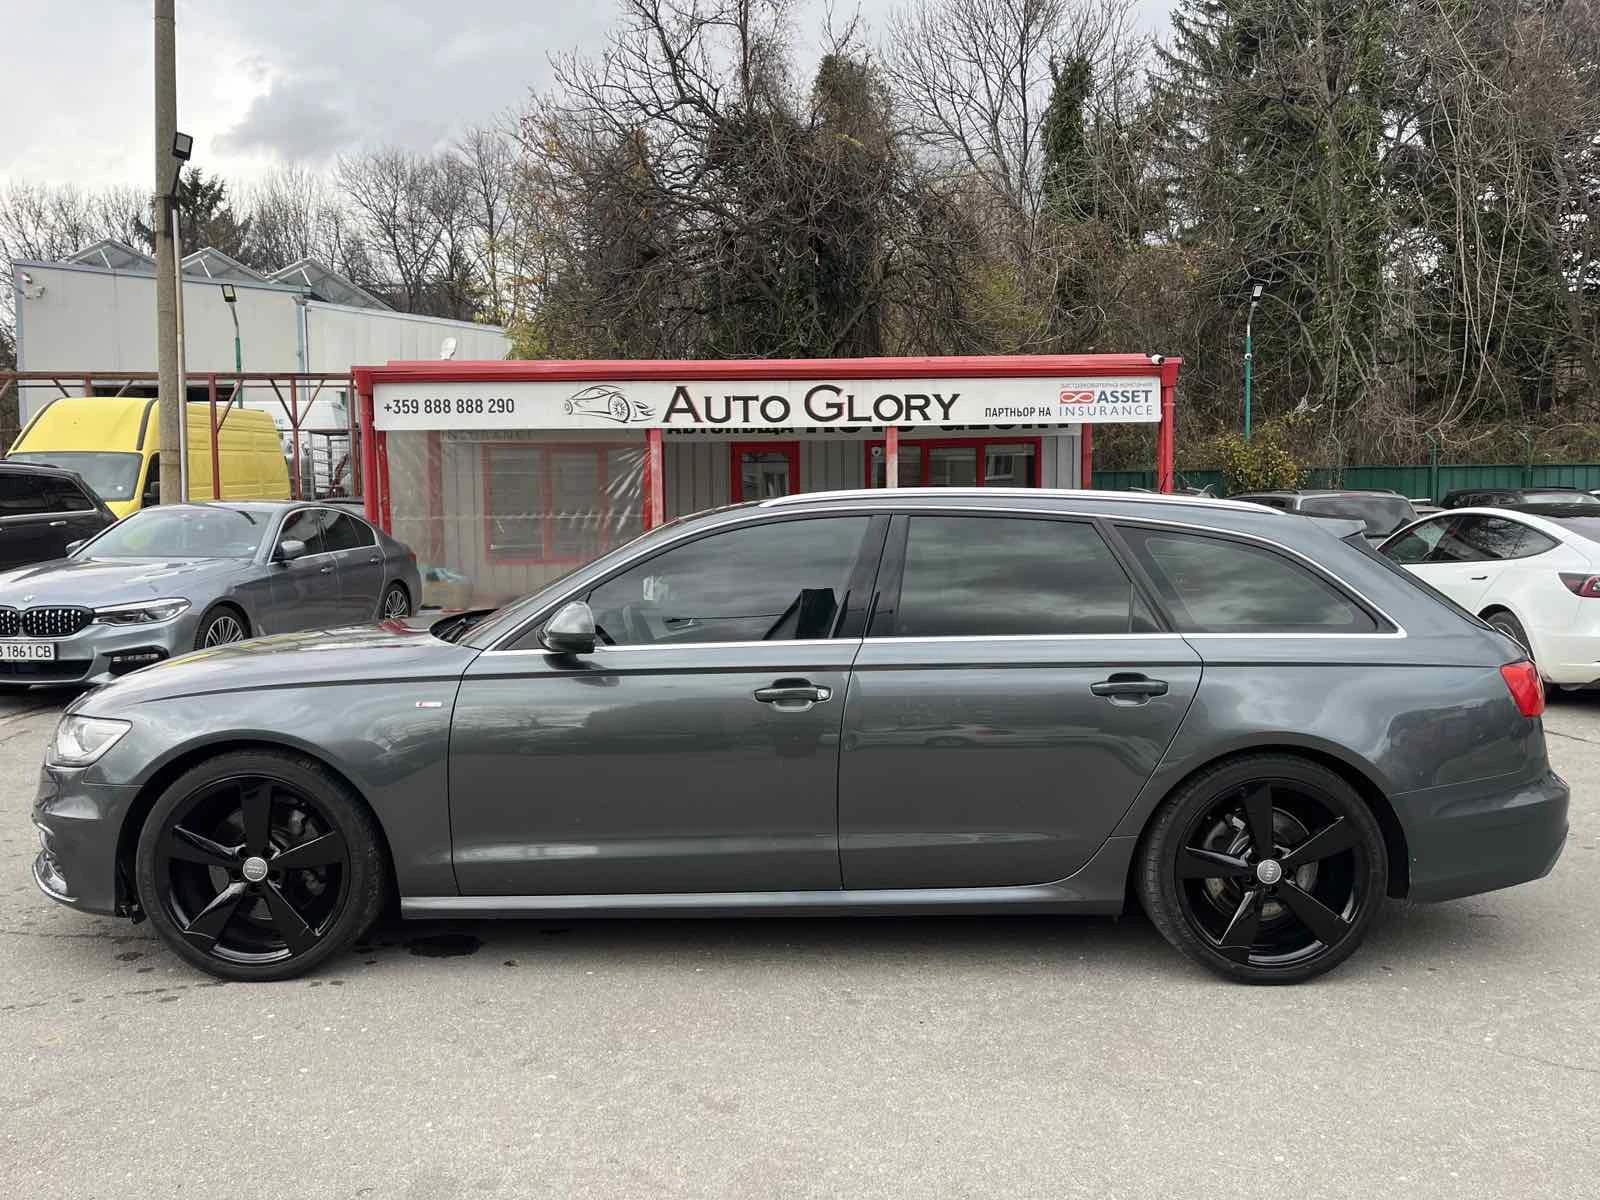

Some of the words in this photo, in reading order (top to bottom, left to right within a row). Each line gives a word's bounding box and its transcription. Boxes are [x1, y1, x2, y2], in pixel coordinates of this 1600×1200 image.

[1097, 390, 1153, 403] ASSET
[384, 399, 419, 414] +359
[424, 399, 451, 414] 888
[456, 398, 484, 414] 888
[488, 398, 515, 414] 290
[985, 407, 1035, 417] ПАРТНЬОР
[1038, 406, 1052, 417] НА
[1059, 404, 1153, 417] INSURANCE
[7, 646, 32, 657] 1861
